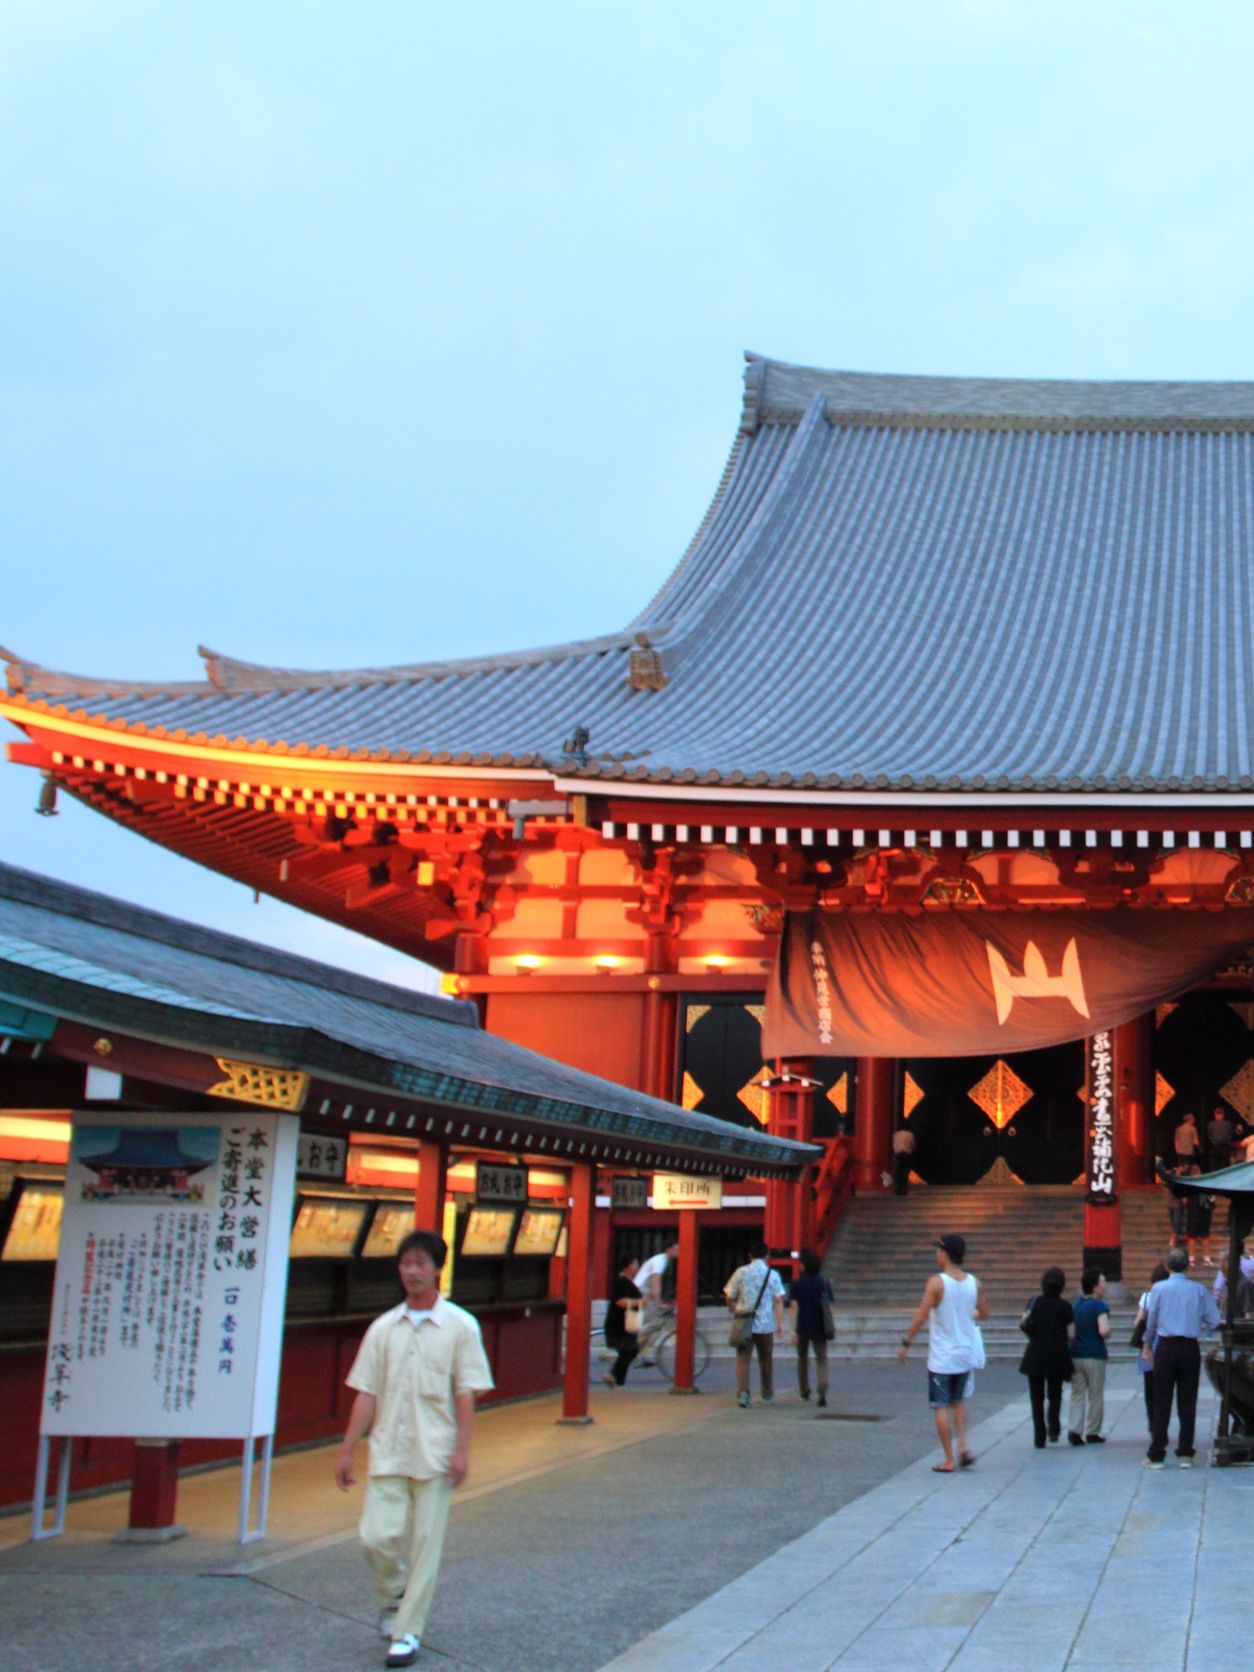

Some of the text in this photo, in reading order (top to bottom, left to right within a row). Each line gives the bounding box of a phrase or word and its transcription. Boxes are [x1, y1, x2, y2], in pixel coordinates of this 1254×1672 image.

[213, 1126, 246, 1271] ご寄進のお願い
[236, 1127, 268, 1270] 本堂大営繕
[665, 1181, 710, 1196] 朱印所
